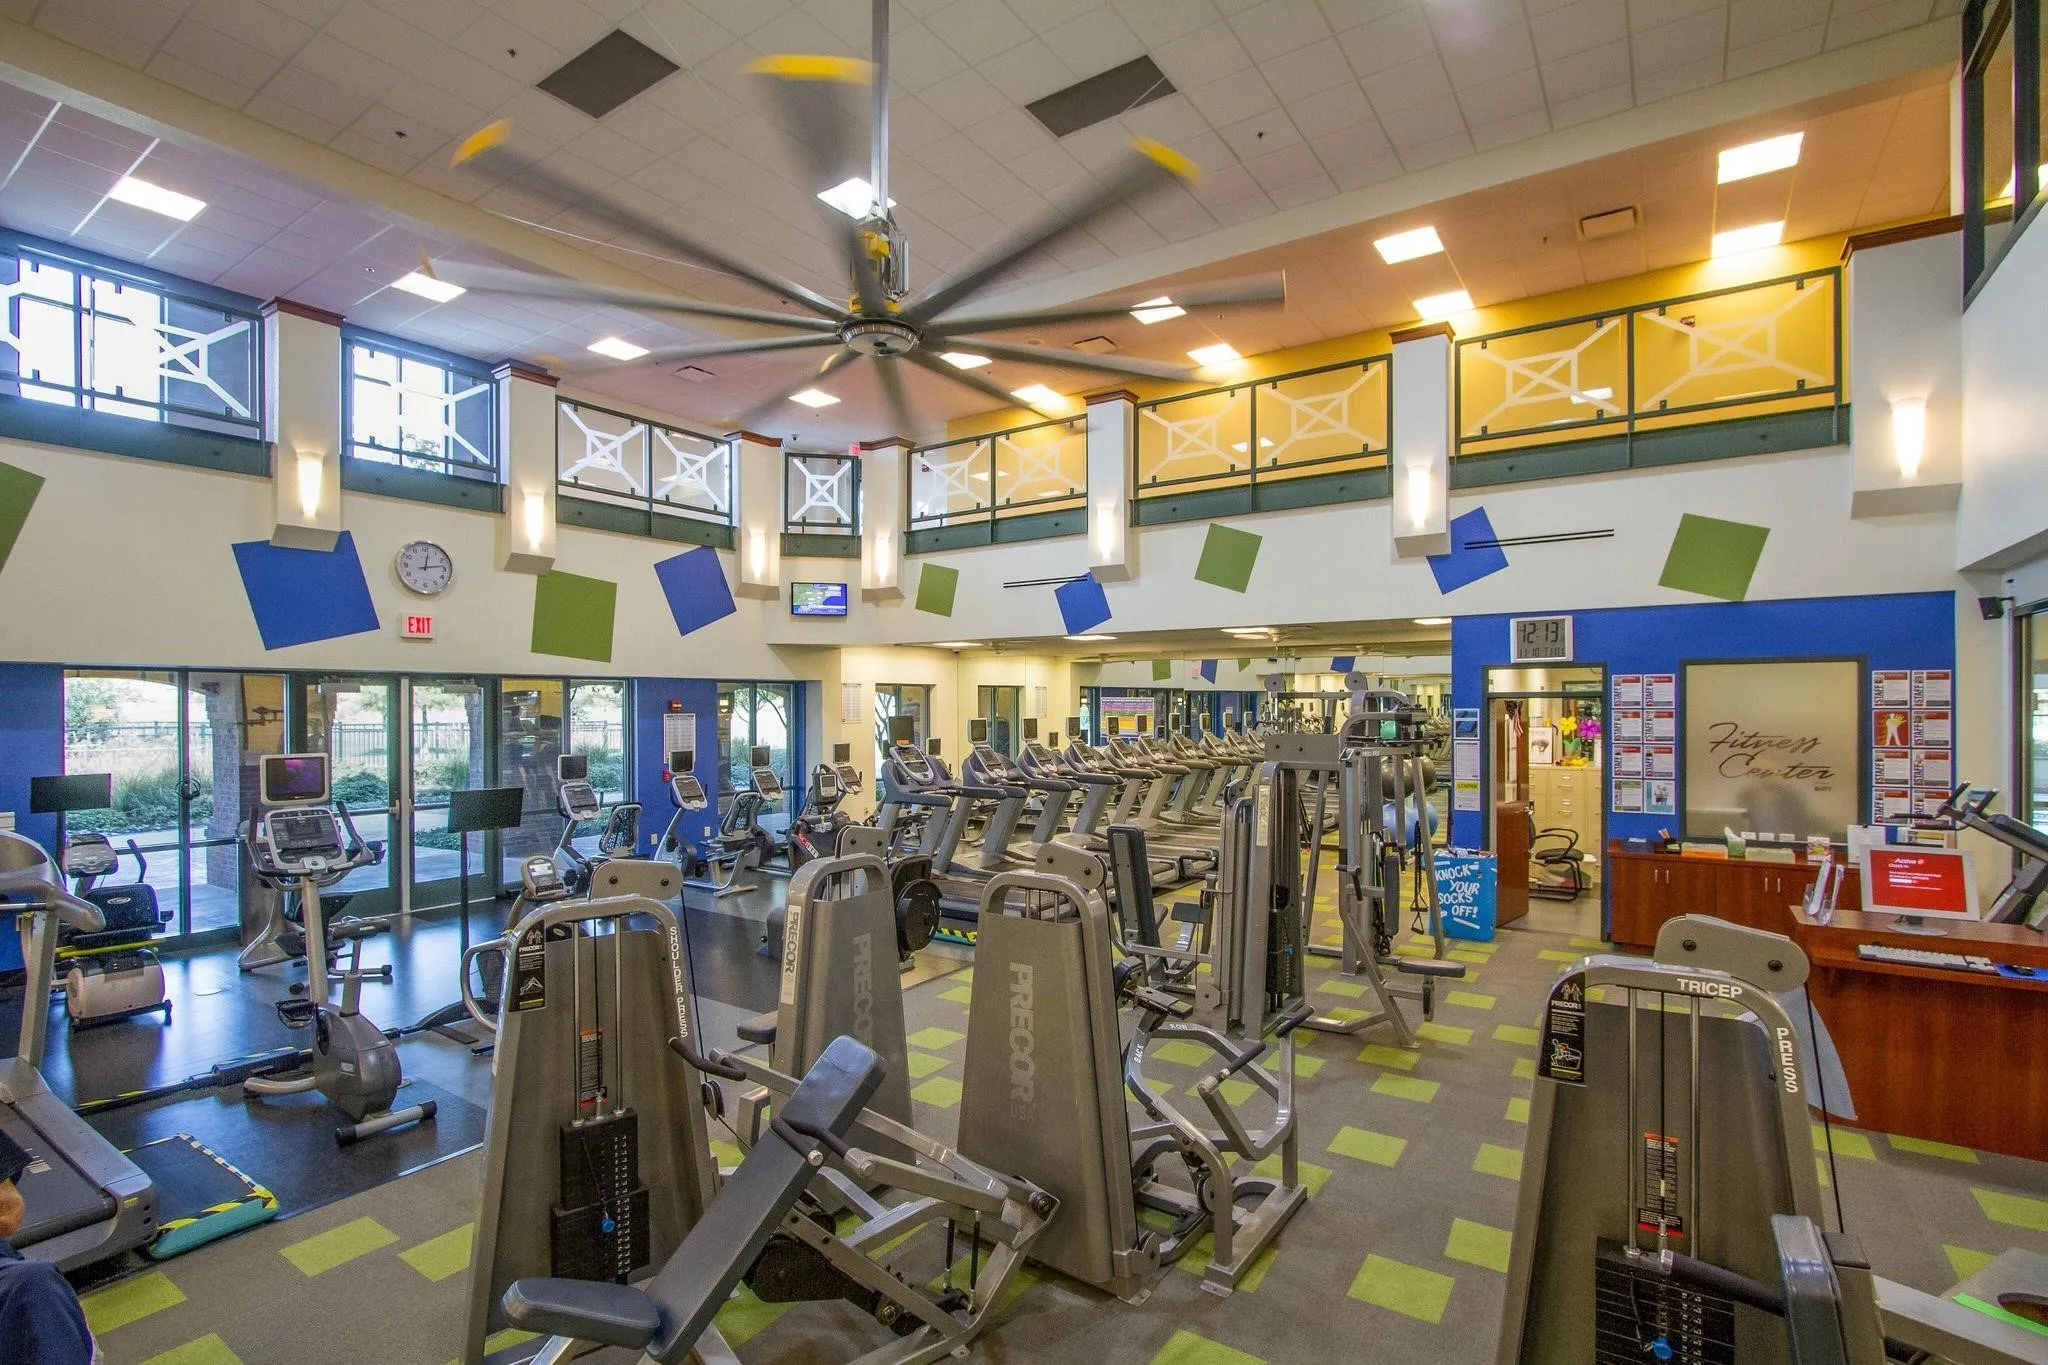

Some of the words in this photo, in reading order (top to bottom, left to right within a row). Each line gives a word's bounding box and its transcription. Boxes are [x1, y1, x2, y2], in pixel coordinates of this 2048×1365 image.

[407, 616, 432, 634] EXIT
[1523, 621, 1559, 643] 12:13
[1613, 685, 1621, 705] STAFF
[1645, 685, 1653, 705] STAFF
[1874, 685, 1884, 704] STAFF
[1914, 685, 1924, 704] STAFF
[1613, 720, 1621, 740] STAFF
[1645, 720, 1653, 740] STAFF
[1709, 722, 1822, 754] Fitness
[1914, 724, 1924, 743] STAFF
[1613, 756, 1621, 775] STAFF
[1645, 756, 1653, 775] STAFF
[1719, 749, 1835, 779] Center
[1875, 762, 1884, 782] STAFF
[1914, 764, 1924, 783] STAFF
[1874, 800, 1884, 820] STAFF
[1435, 864, 1471, 881] KNOCK
[1450, 880, 1480, 895] YOUR
[1438, 892, 1473, 904] SOCKS
[1451, 905, 1478, 918] OFF!
[785, 911, 799, 974] PRECOR
[670, 926, 683, 994] SHOULDER
[677, 997, 688, 1038] PRESS
[853, 932, 875, 1042] PRECO
[1551, 1000, 1578, 1009] PRECOR
[1009, 962, 1035, 1102] PRECOR
[1677, 978, 1743, 999] TRICEP
[1776, 1027, 1798, 1093] PRESS
[1133, 1044, 1144, 1063] BACK
